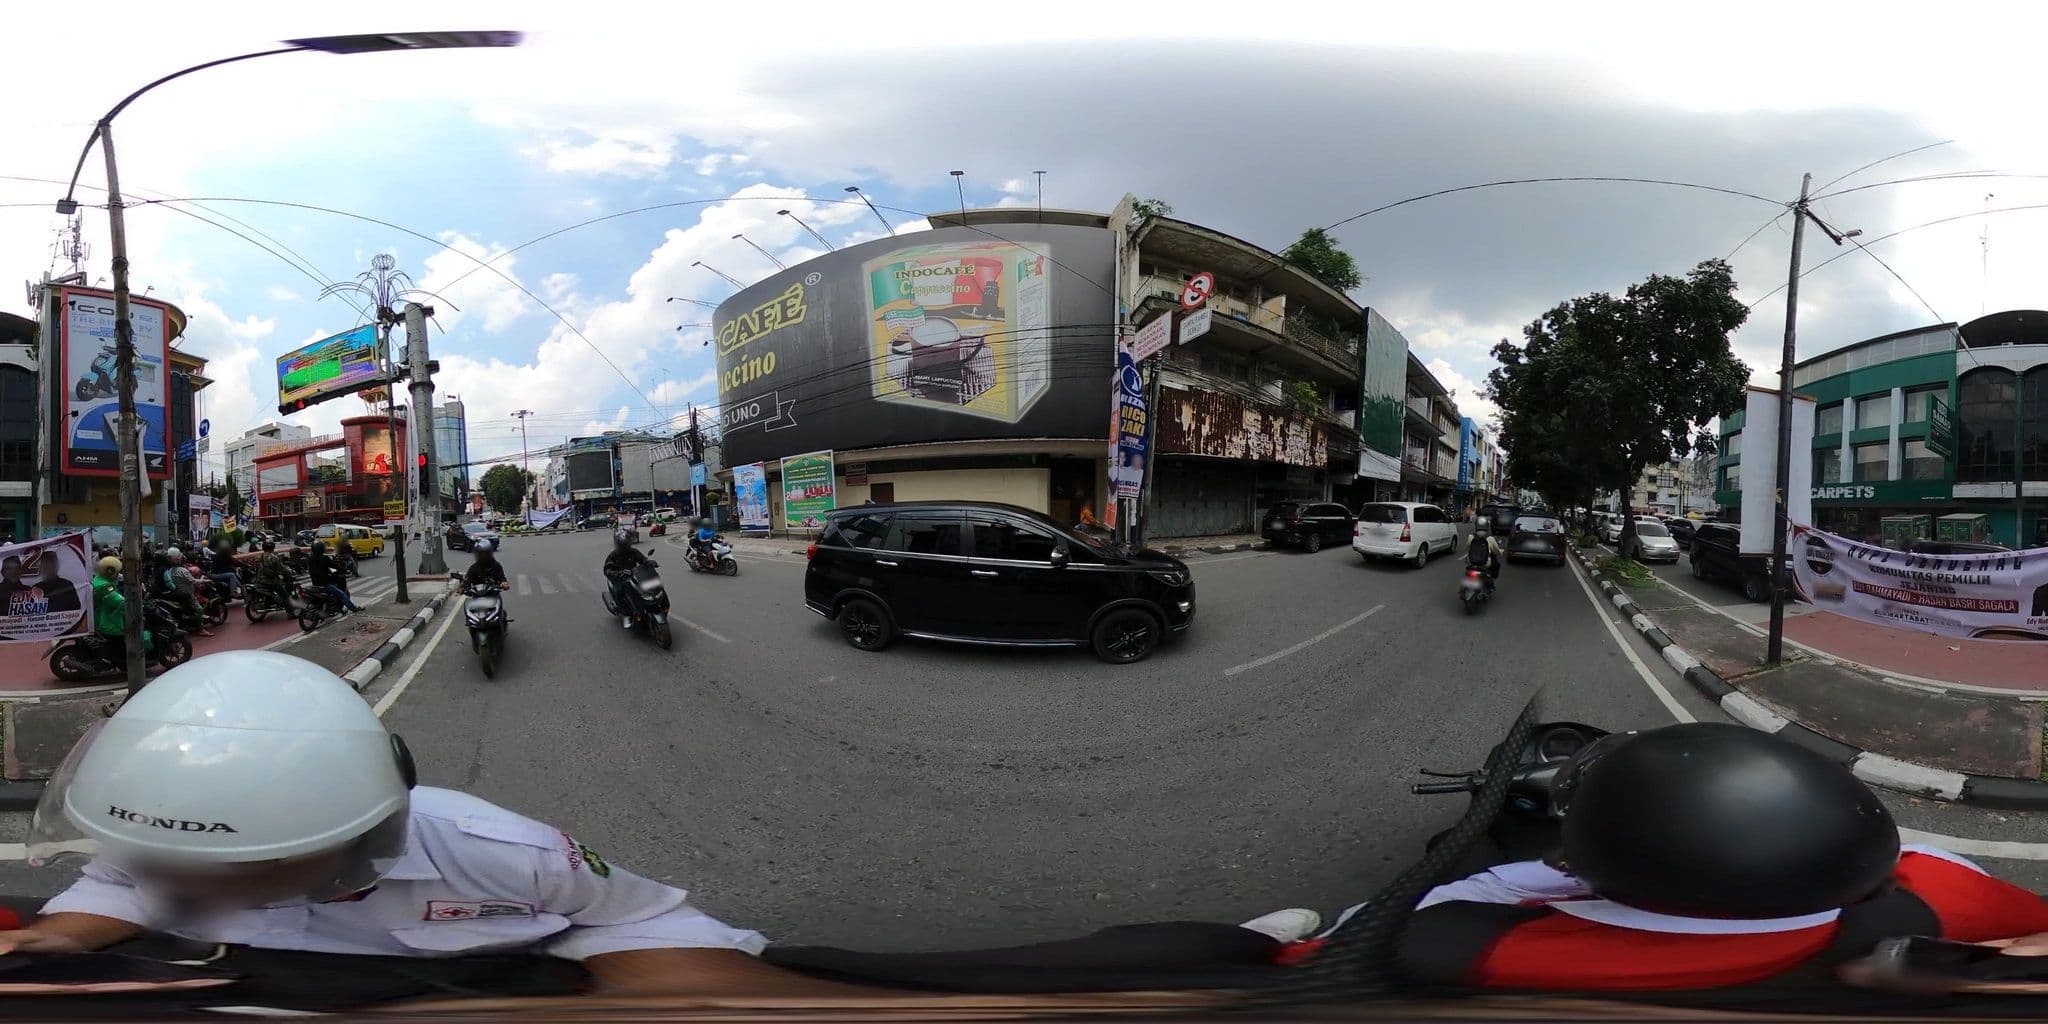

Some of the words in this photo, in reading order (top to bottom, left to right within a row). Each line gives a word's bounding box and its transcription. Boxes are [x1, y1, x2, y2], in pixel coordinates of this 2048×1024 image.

[895, 264, 976, 279] INDOCAFÉ
[900, 280, 971, 297] Cappuccino
[731, 402, 760, 424] UNO
[1121, 405, 1146, 425] RICO
[1121, 419, 1145, 437] ZAKI
[1811, 485, 1875, 499] CARPETS
[9, 602, 48, 616] HASAN
[1918, 595, 1947, 606] HASAN
[1949, 598, 1976, 609] BASRI
[1979, 600, 2015, 611] SAGALA
[107, 804, 240, 833] HONDA
